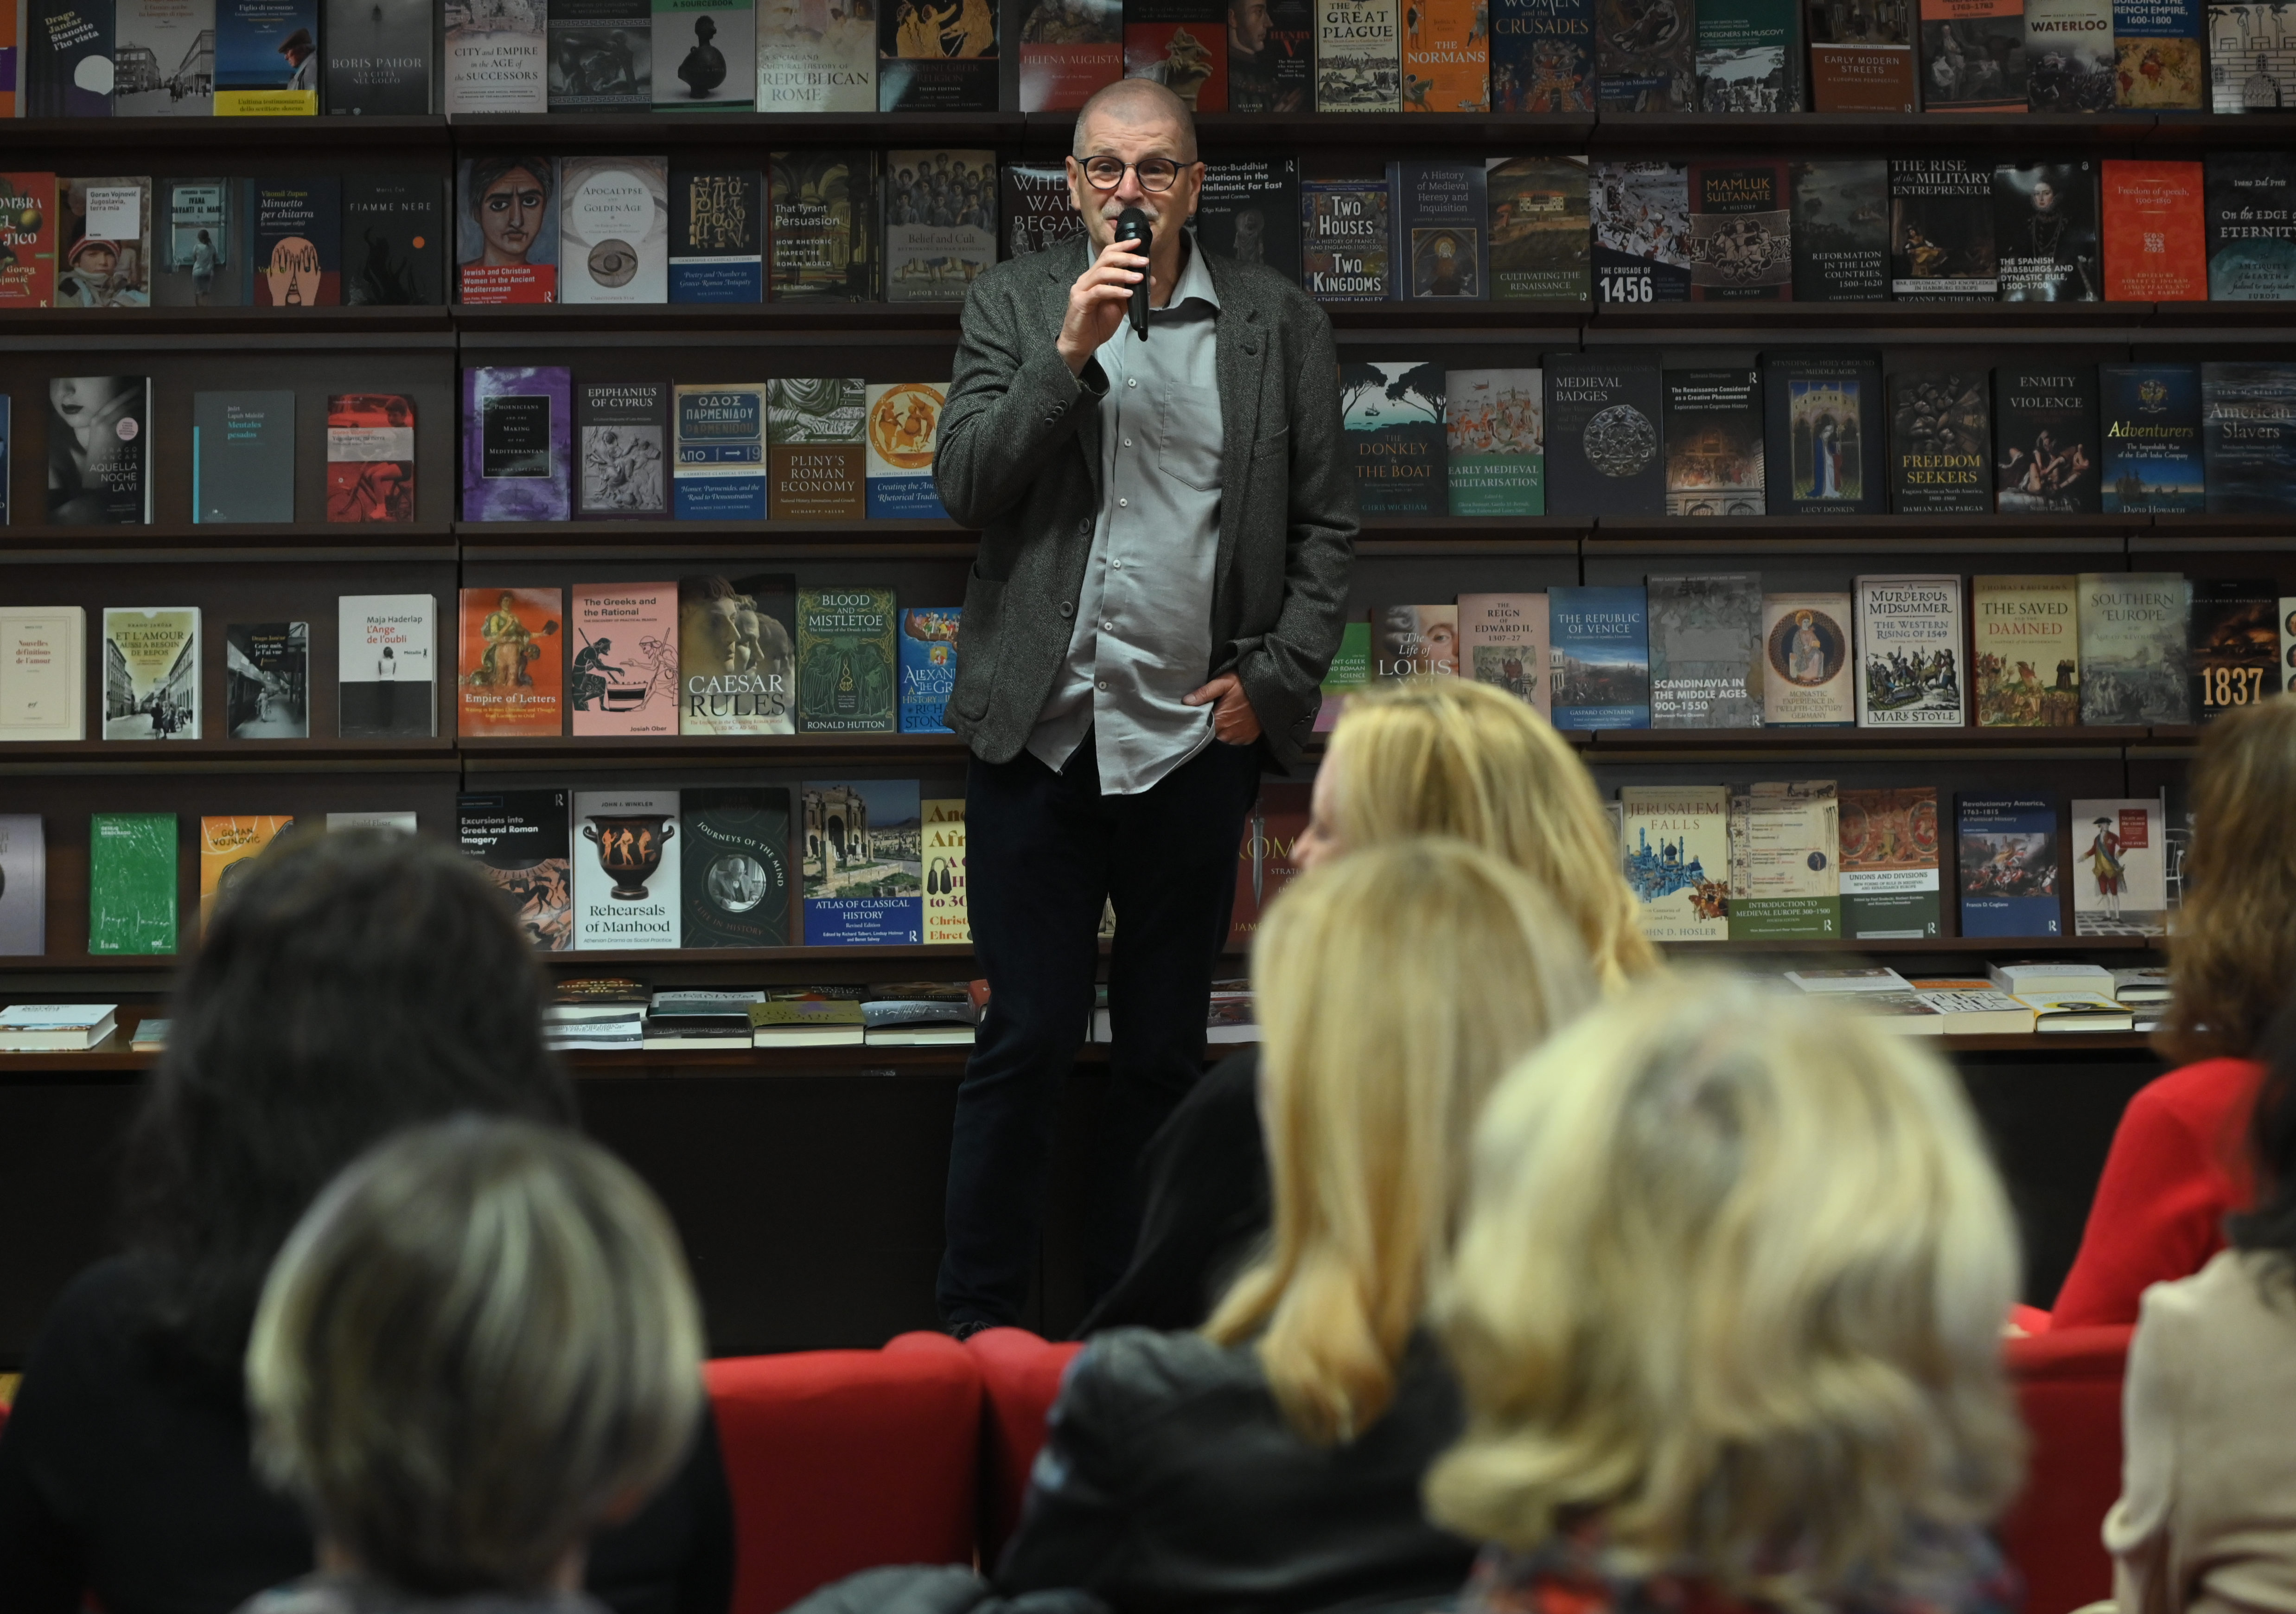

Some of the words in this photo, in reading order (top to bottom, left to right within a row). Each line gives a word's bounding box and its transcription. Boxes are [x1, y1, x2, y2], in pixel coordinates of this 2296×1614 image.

[1327, 11, 1388, 23] GREAT
[1496, 19, 1588, 34] CRUSADES
[2032, 20, 2107, 32] WATERLOO
[51, 24, 94, 42] Stanotte
[1324, 26, 1393, 38] PLAGUE
[53, 38, 72, 51] l'ho
[75, 31, 99, 44] vista
[1408, 51, 1486, 63] NORMANS
[332, 59, 371, 68] BORIS
[376, 58, 422, 68] PAHOR
[763, 73, 869, 85] REPUBLICAN
[772, 89, 821, 101] ROME
[1892, 160, 1925, 172] THE
[1931, 160, 1966, 171] RISE
[1894, 174, 1901, 183] of
[1903, 174, 1914, 182] the
[1916, 173, 1990, 184] MILITARY
[1707, 178, 1770, 191] MAMLUK
[1894, 186, 1991, 195] ENTREPRENEUR
[1707, 192, 1771, 202] SULTANATE
[351, 203, 394, 211] FIAMME
[798, 205, 827, 214] Tyrant
[261, 211, 276, 221] per
[776, 216, 840, 225] Persuasion
[1600, 277, 1652, 302] 1456
[1556, 378, 1622, 387] MEDIEVAL
[2021, 377, 2076, 387] ENMITY
[588, 388, 657, 397] EPIPHANIUS
[1556, 391, 1608, 401] BADGES
[592, 398, 606, 407] OF
[610, 398, 653, 407] CYPRUS
[698, 397, 740, 406] ΟΔΟΣ
[2010, 397, 2083, 408] VIOLENCE
[687, 409, 753, 420] ΠΑΡΜΕΝΙΔΟΥ
[2209, 403, 2290, 418] American
[2107, 420, 2194, 437] Adventurers
[2223, 423, 2280, 439] Slavers
[1903, 455, 1980, 468] FREEDOM
[89, 463, 137, 472] AQUELLA
[1448, 467, 1480, 475] EARLY
[1484, 466, 1538, 474] MEDIEVAL
[791, 469, 844, 479] ROMAN
[1907, 472, 1977, 483] SEEKERS
[113, 484, 125, 492] LA
[781, 481, 855, 492] ECONOMY
[1449, 478, 1538, 487] MILITARISATION
[823, 595, 870, 606] BLOOD
[1871, 591, 1947, 602] MURDEROUS
[1870, 603, 1952, 614] MIDSUMMER
[1983, 603, 2016, 615] THE
[2020, 603, 2068, 615] SAVED
[809, 615, 883, 626] MISTLETOE
[1586, 614, 1639, 623] REPUBLIC
[367, 625, 395, 635] L'Ange
[1588, 624, 1629, 633] VENICE
[1989, 623, 2062, 634] DAMNED
[134, 631, 185, 640] L'AMOUR
[1379, 660, 1451, 675] LOUIS
[689, 674, 784, 693] CAESAR
[1655, 679, 1728, 690] SCANDINAVIA
[2203, 667, 2263, 705] 1837
[466, 694, 503, 705] Empire
[506, 693, 517, 702] of
[520, 695, 556, 703] Letters
[1655, 691, 1673, 699] THE
[1677, 690, 1715, 699] MIDDLE
[1719, 690, 1747, 698] AGES
[690, 693, 786, 717] RULES
[1874, 711, 1909, 723] MARK
[1913, 711, 1955, 721] STOYLE
[1629, 803, 1719, 818] JERUSALEM
[1651, 820, 1700, 830] FALLS
[222, 827, 253, 837] GORAN
[213, 835, 260, 846] VOJNOVIĆ
[697, 822, 740, 842] JOURNEYS
[760, 843, 774, 858] THE
[773, 861, 783, 887] MIND
[590, 905, 665, 916] Rehearsals
[843, 911, 884, 920] HISTORY
[586, 922, 599, 933] of
[603, 920, 670, 932] Manhood
